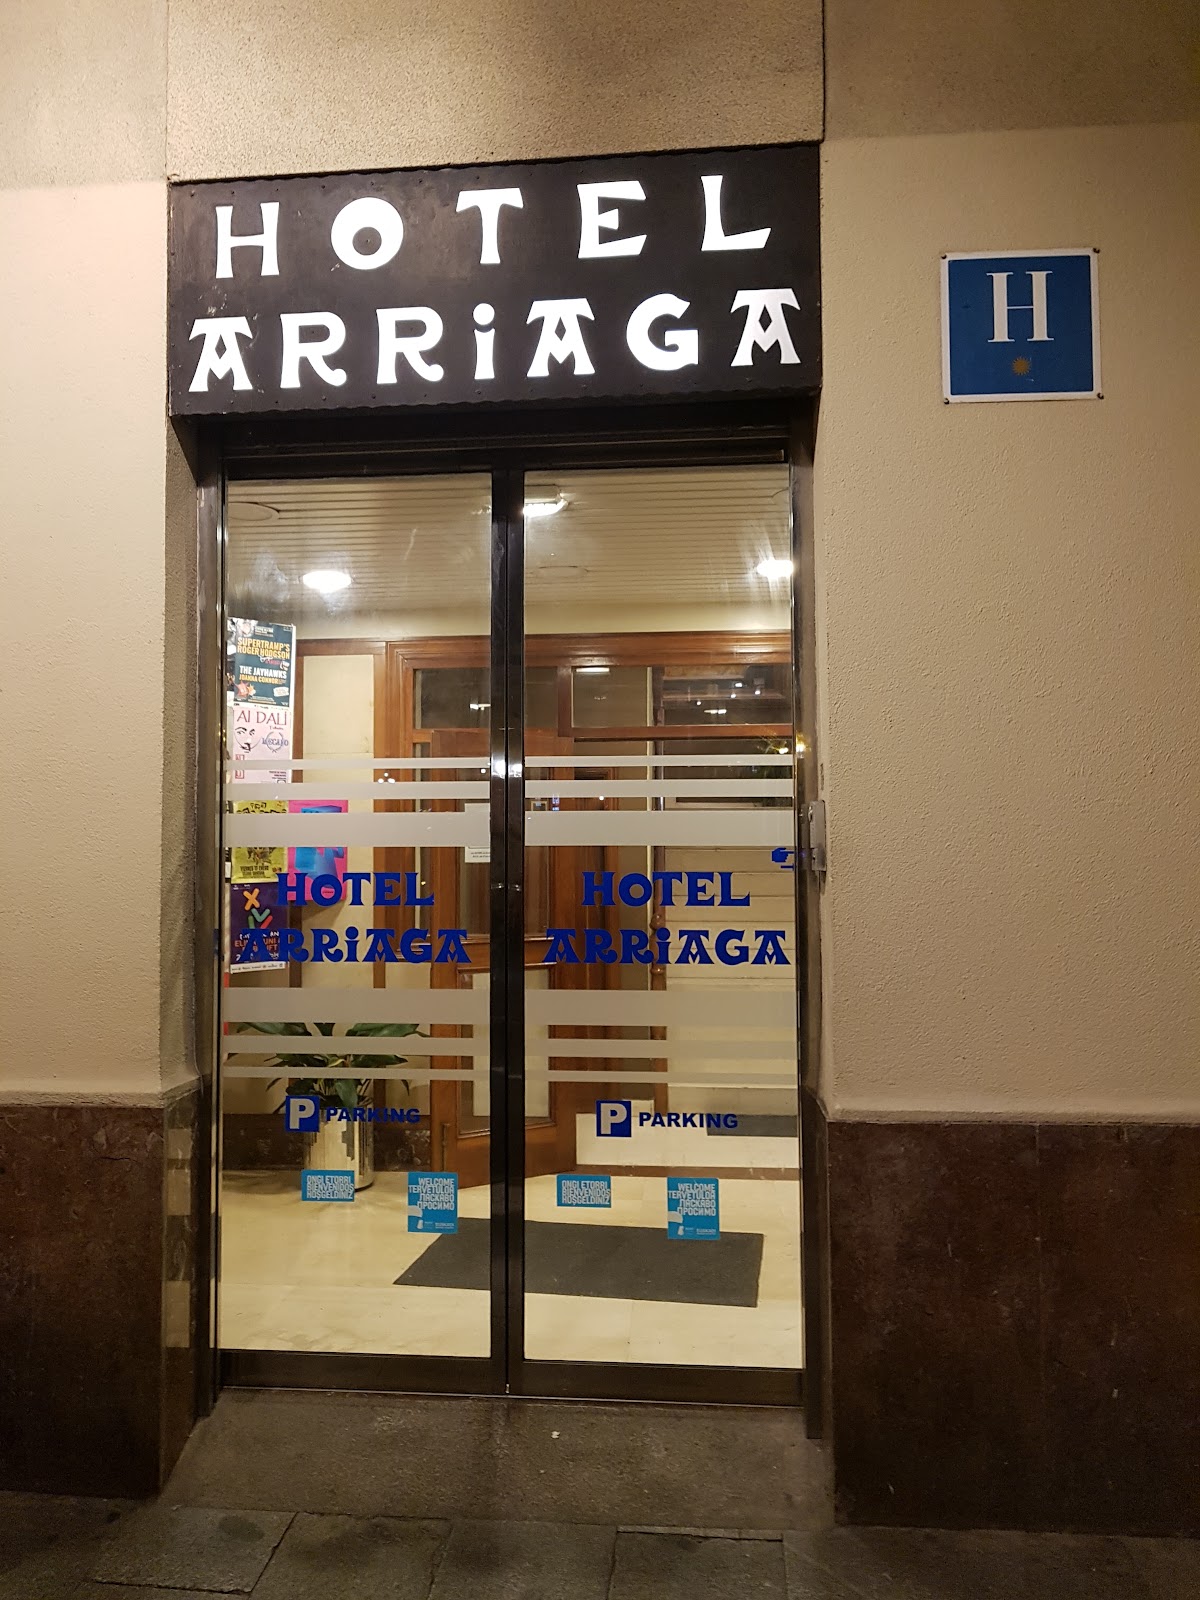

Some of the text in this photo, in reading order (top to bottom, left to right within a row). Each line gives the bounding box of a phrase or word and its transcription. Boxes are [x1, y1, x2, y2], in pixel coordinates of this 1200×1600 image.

[215, 174, 771, 279] HOTEL
[986, 270, 1054, 343] H
[237, 637, 290, 652] SUPERTRAMP'S
[237, 645, 290, 660] ROGER HODGSON
[239, 665, 287, 680] THE JAYHAWKS
[276, 872, 434, 906] HOTEL
[582, 871, 750, 906] HOTEL
[289, 1098, 420, 1130] P PARKING
[600, 1102, 738, 1135] P PARKING
[307, 1183, 354, 1192] BIENVENIDOS
[418, 1177, 454, 1186] WELCOME
[677, 1183, 716, 1192] WELCOME
[562, 1188, 611, 1197] BIENVENIDOS
